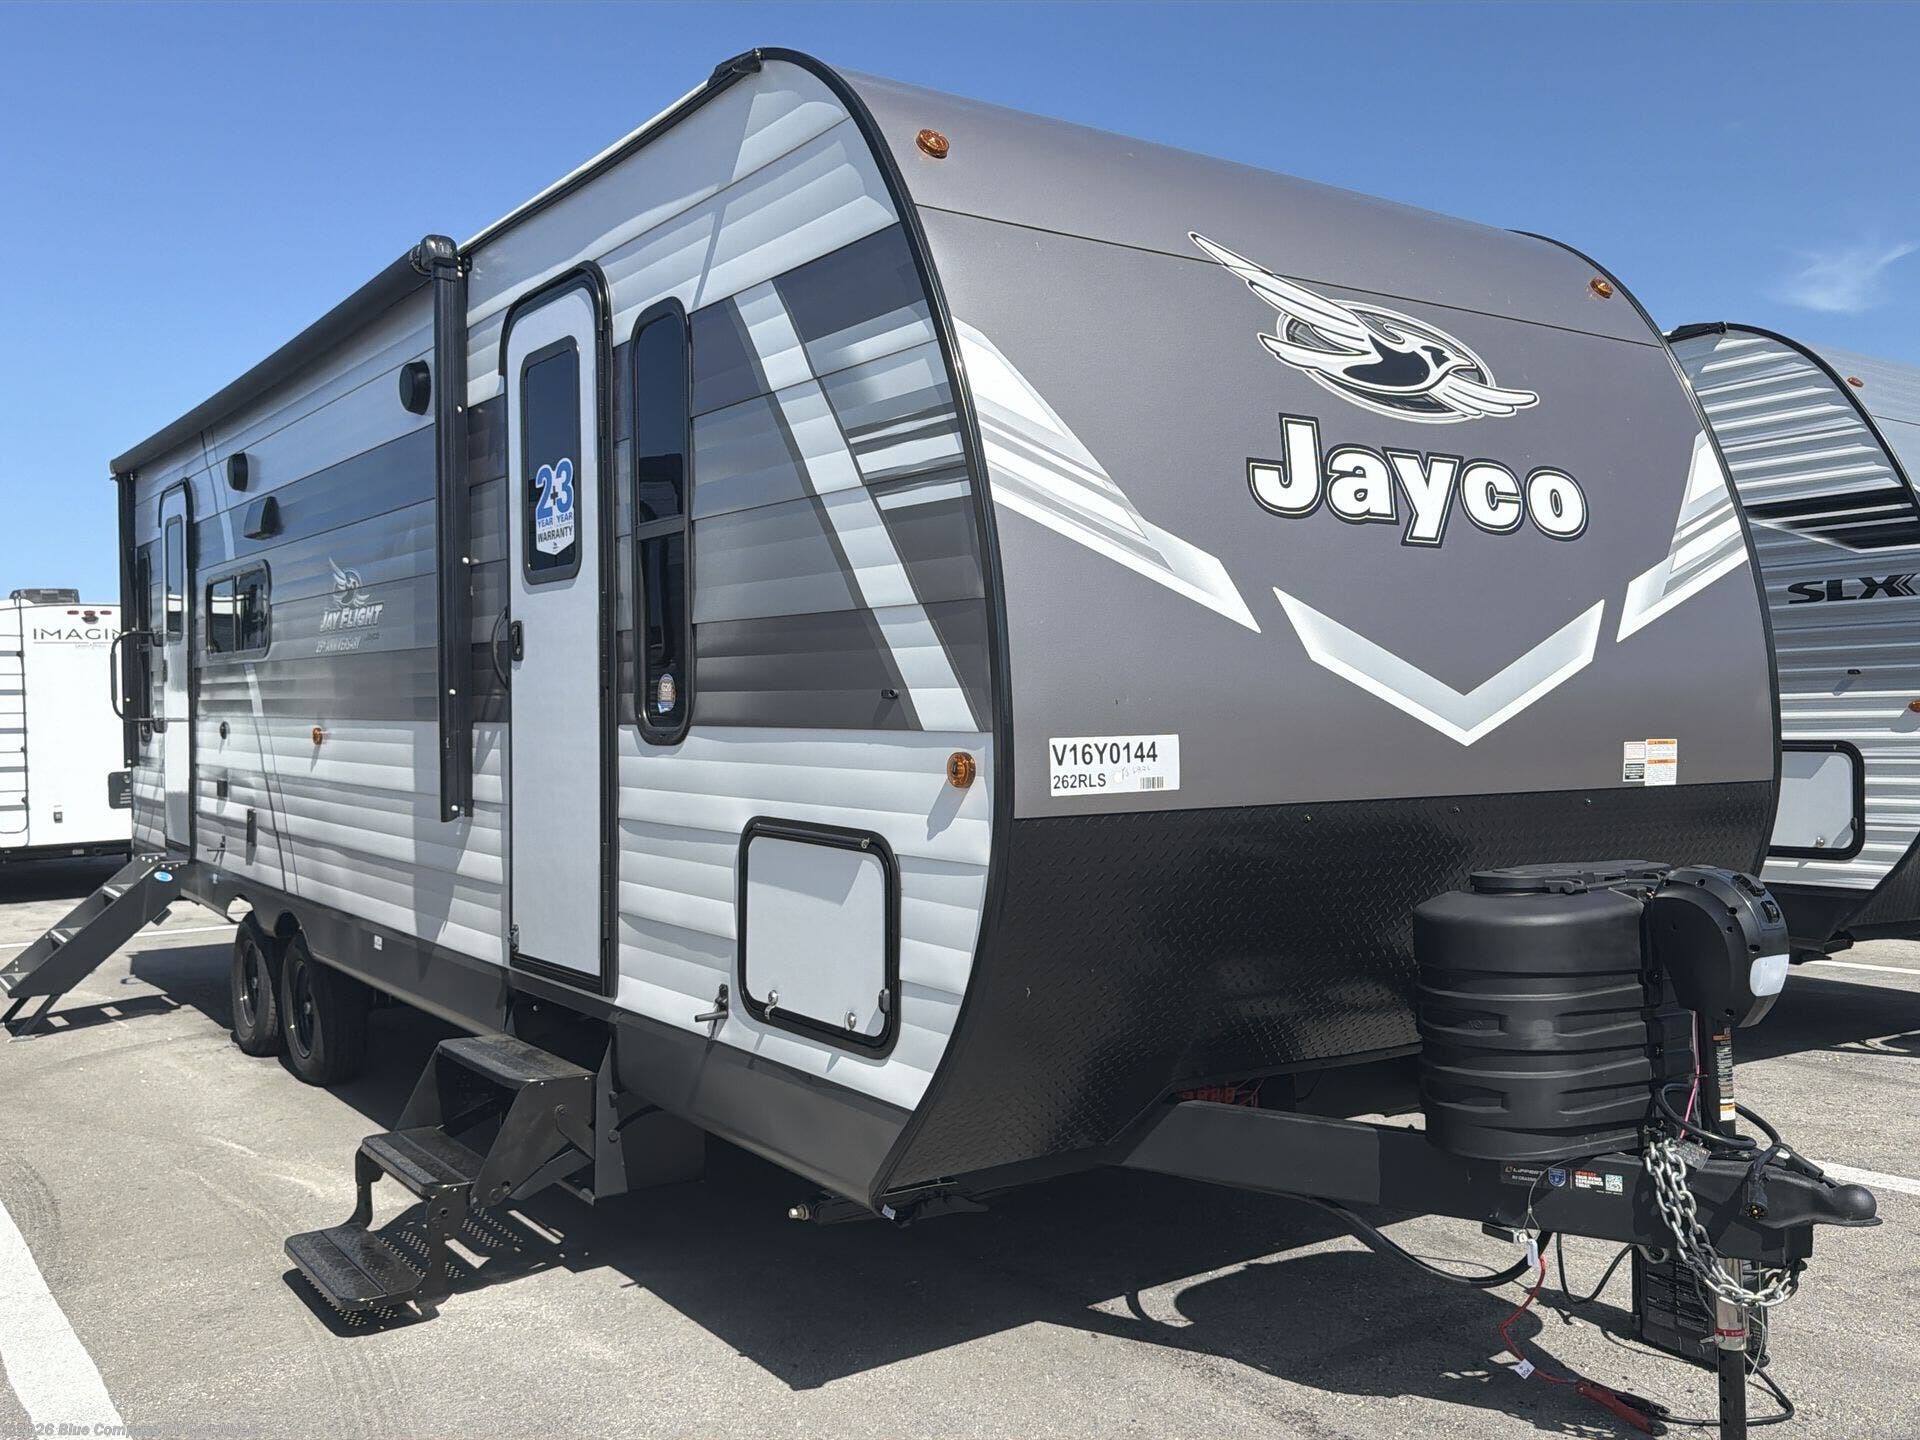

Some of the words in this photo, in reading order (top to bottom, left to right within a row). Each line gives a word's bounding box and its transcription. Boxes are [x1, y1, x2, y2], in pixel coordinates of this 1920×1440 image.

[1246, 413, 1589, 547] Jayco
[538, 517, 553, 529] YEAR
[556, 512, 573, 522] YEAR
[538, 526, 573, 543] WARRANTY
[1787, 573, 1918, 604] SLX
[320, 610, 341, 631] JAY
[340, 604, 383, 628] FLIGHT
[1052, 741, 1158, 766] V16Y0144
[1053, 773, 1106, 789] 262RLS
